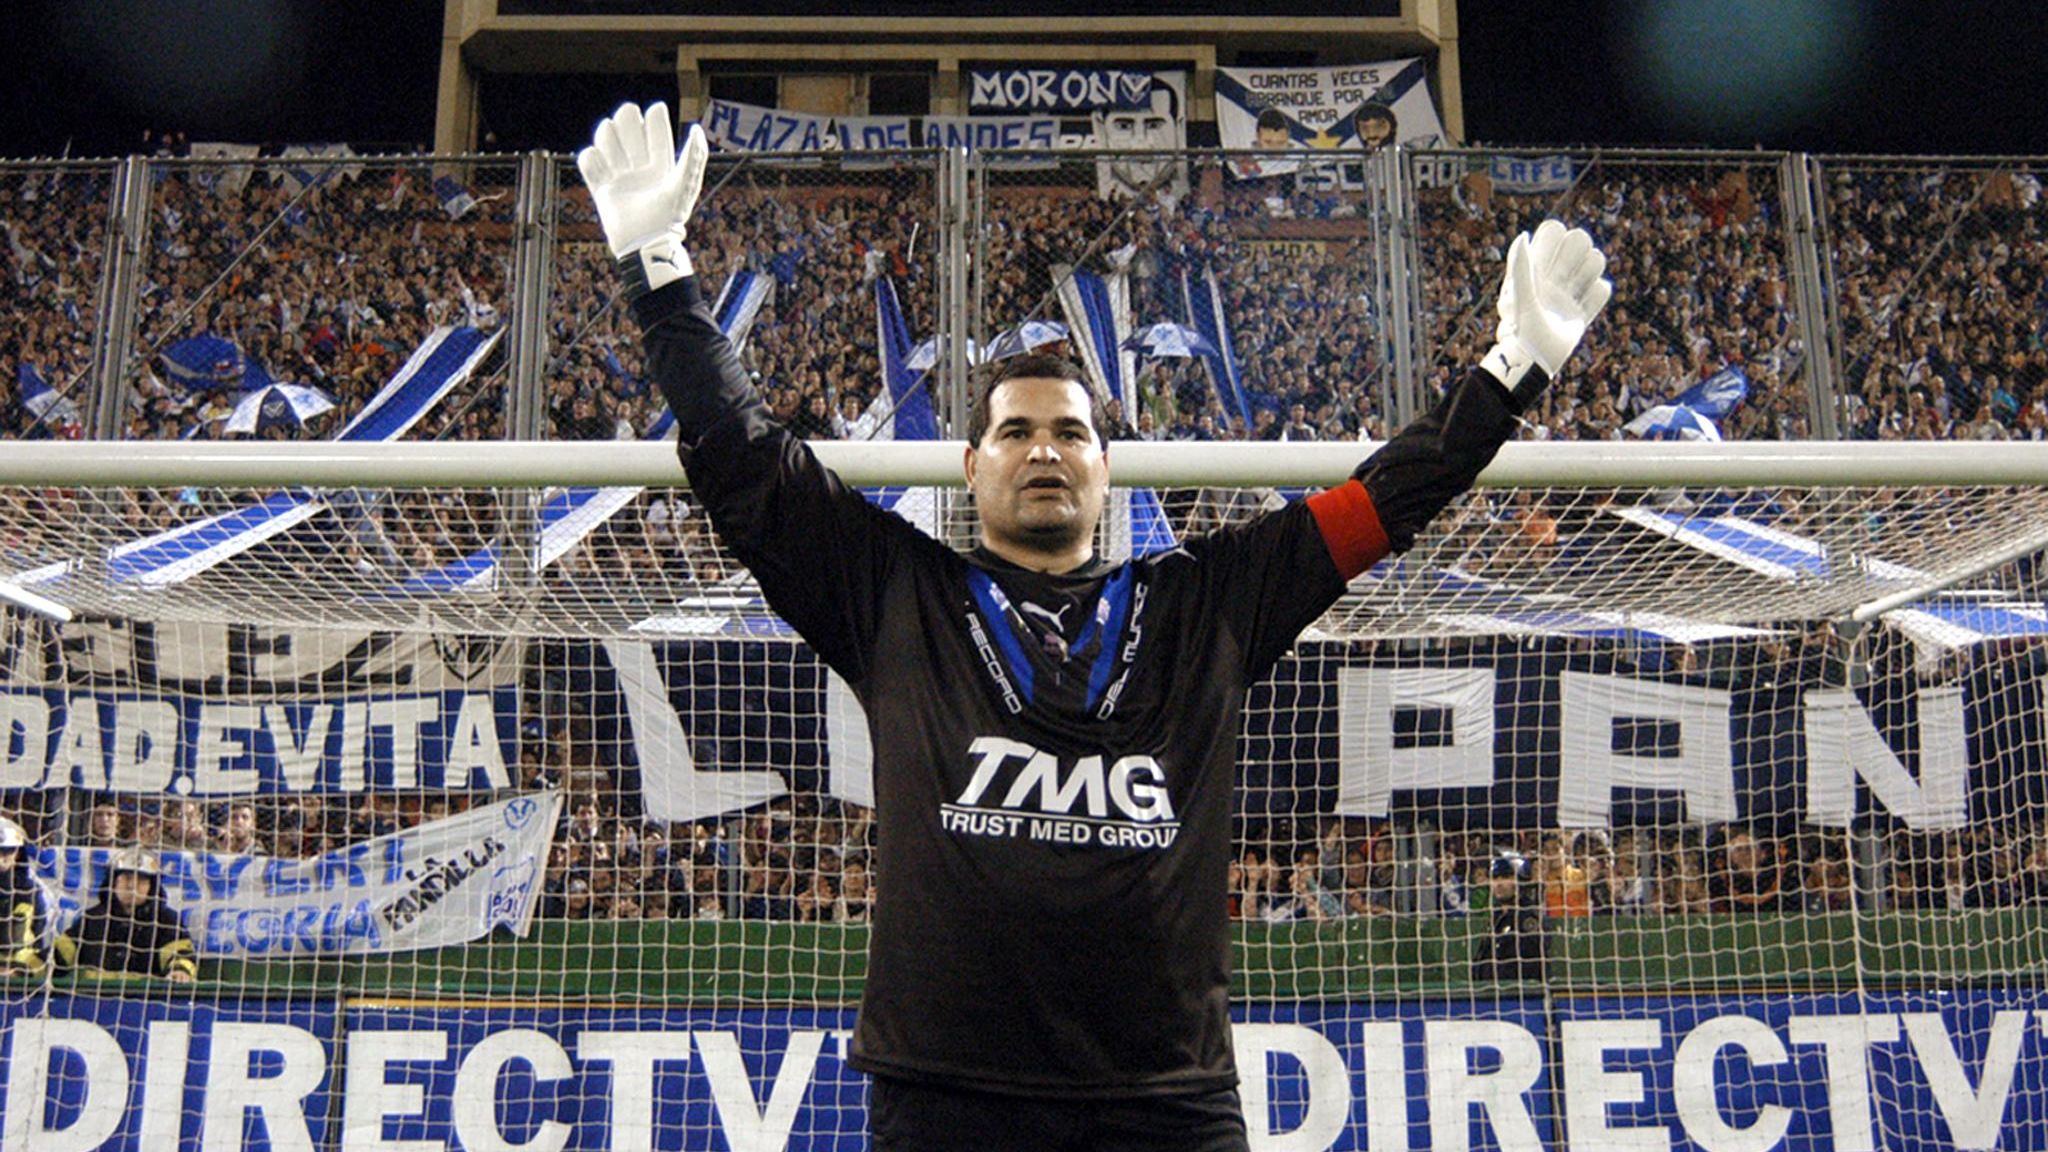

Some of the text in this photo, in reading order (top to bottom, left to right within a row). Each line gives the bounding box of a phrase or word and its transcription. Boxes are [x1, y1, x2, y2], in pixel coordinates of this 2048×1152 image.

[971, 70, 1122, 107] MORON
[1250, 69, 1380, 89] CUANTAS VECES
[1334, 90, 1364, 104] POR
[708, 101, 822, 150] PLAZA
[926, 120, 1055, 156] ANDES
[1298, 109, 1339, 123] AMOR
[965, 612, 1022, 715] RECORD
[1096, 667, 1130, 721] DEL
[956, 736, 1175, 821] TMG
[940, 808, 1179, 849] TRUST MED GROU
[2, 1018, 826, 1152] DIRECTV
[1230, 1011, 2030, 1152] DIRECTV
